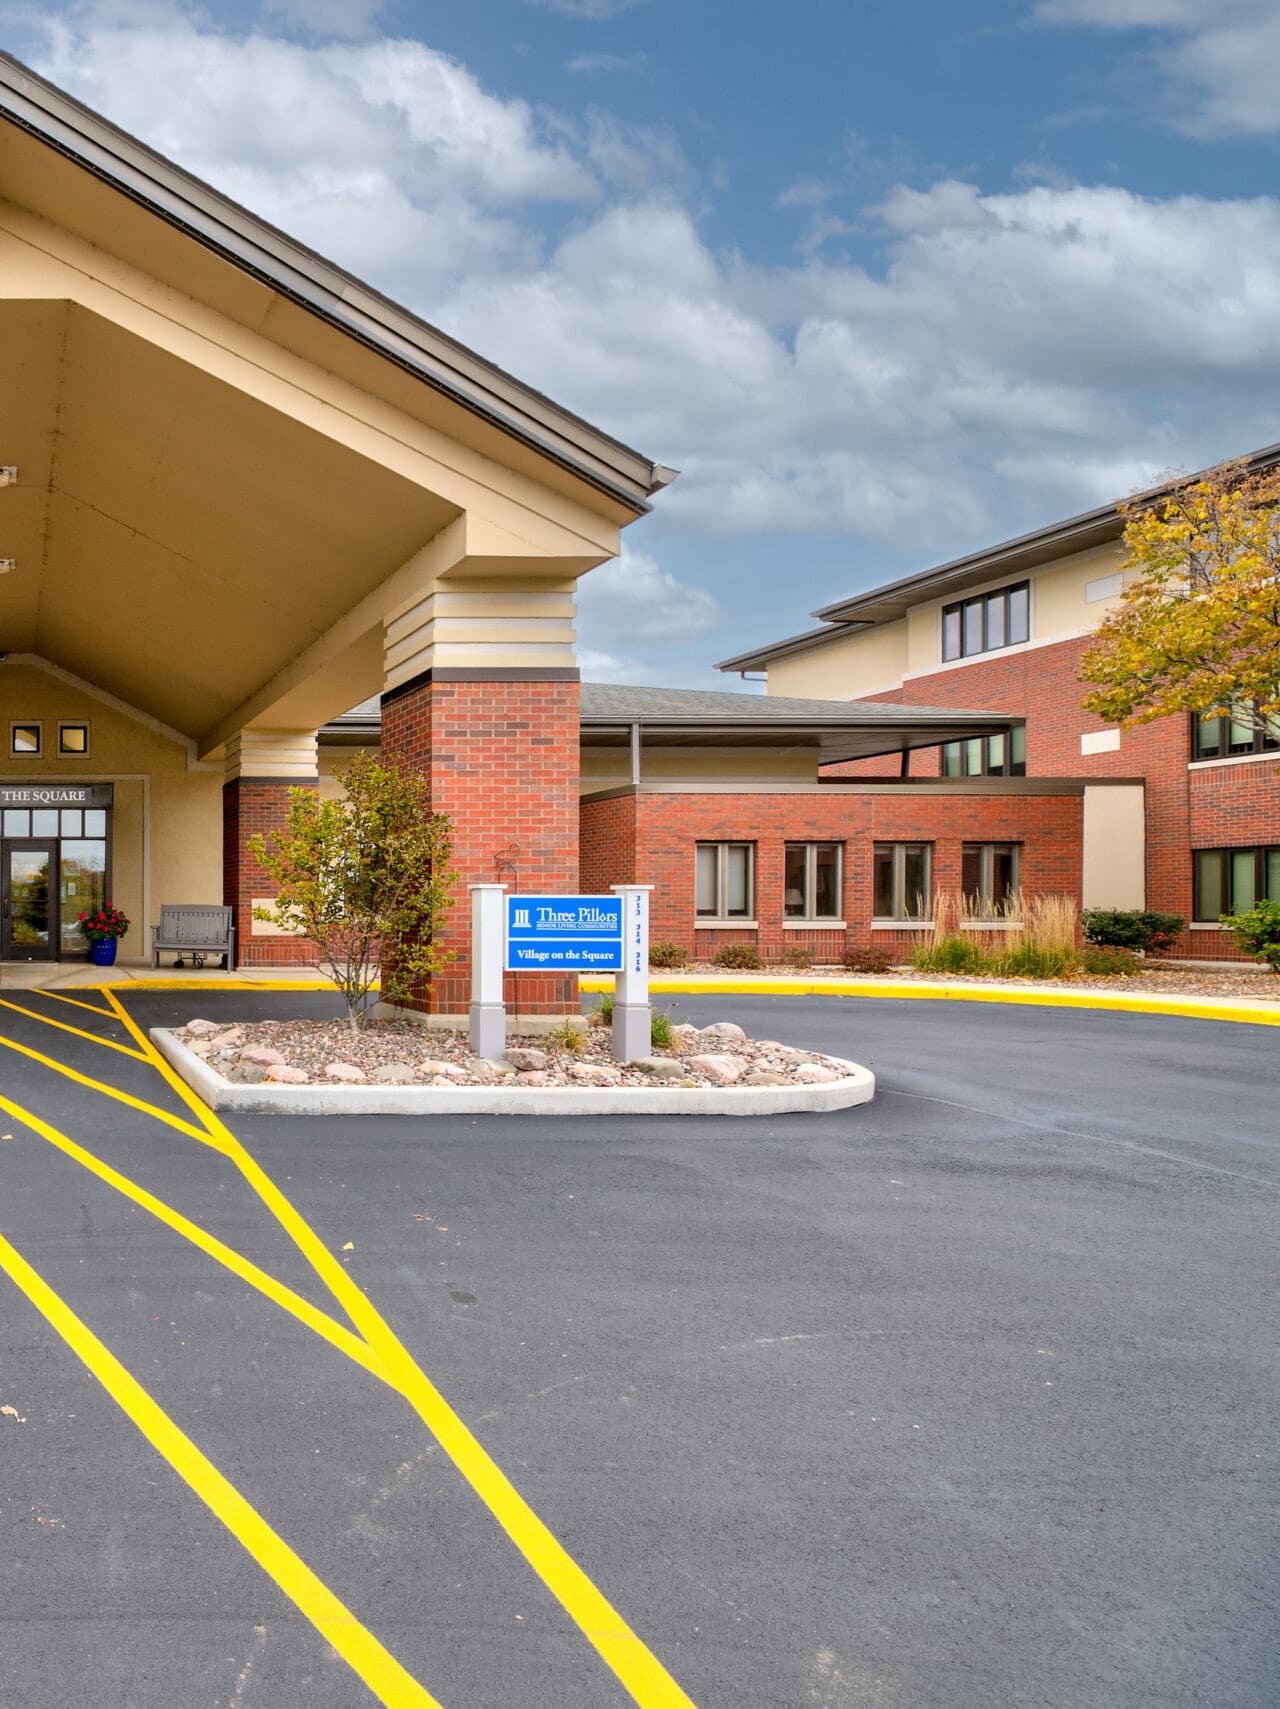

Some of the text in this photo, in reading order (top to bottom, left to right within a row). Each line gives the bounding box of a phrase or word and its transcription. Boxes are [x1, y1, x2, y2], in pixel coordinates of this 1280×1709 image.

[2, 790, 31, 801] THE
[32, 790, 86, 804] SQUARE
[536, 907, 618, 922] Three Pillars
[517, 949, 550, 962] Village
[565, 949, 580, 960] the
[581, 950, 615, 962] Square
